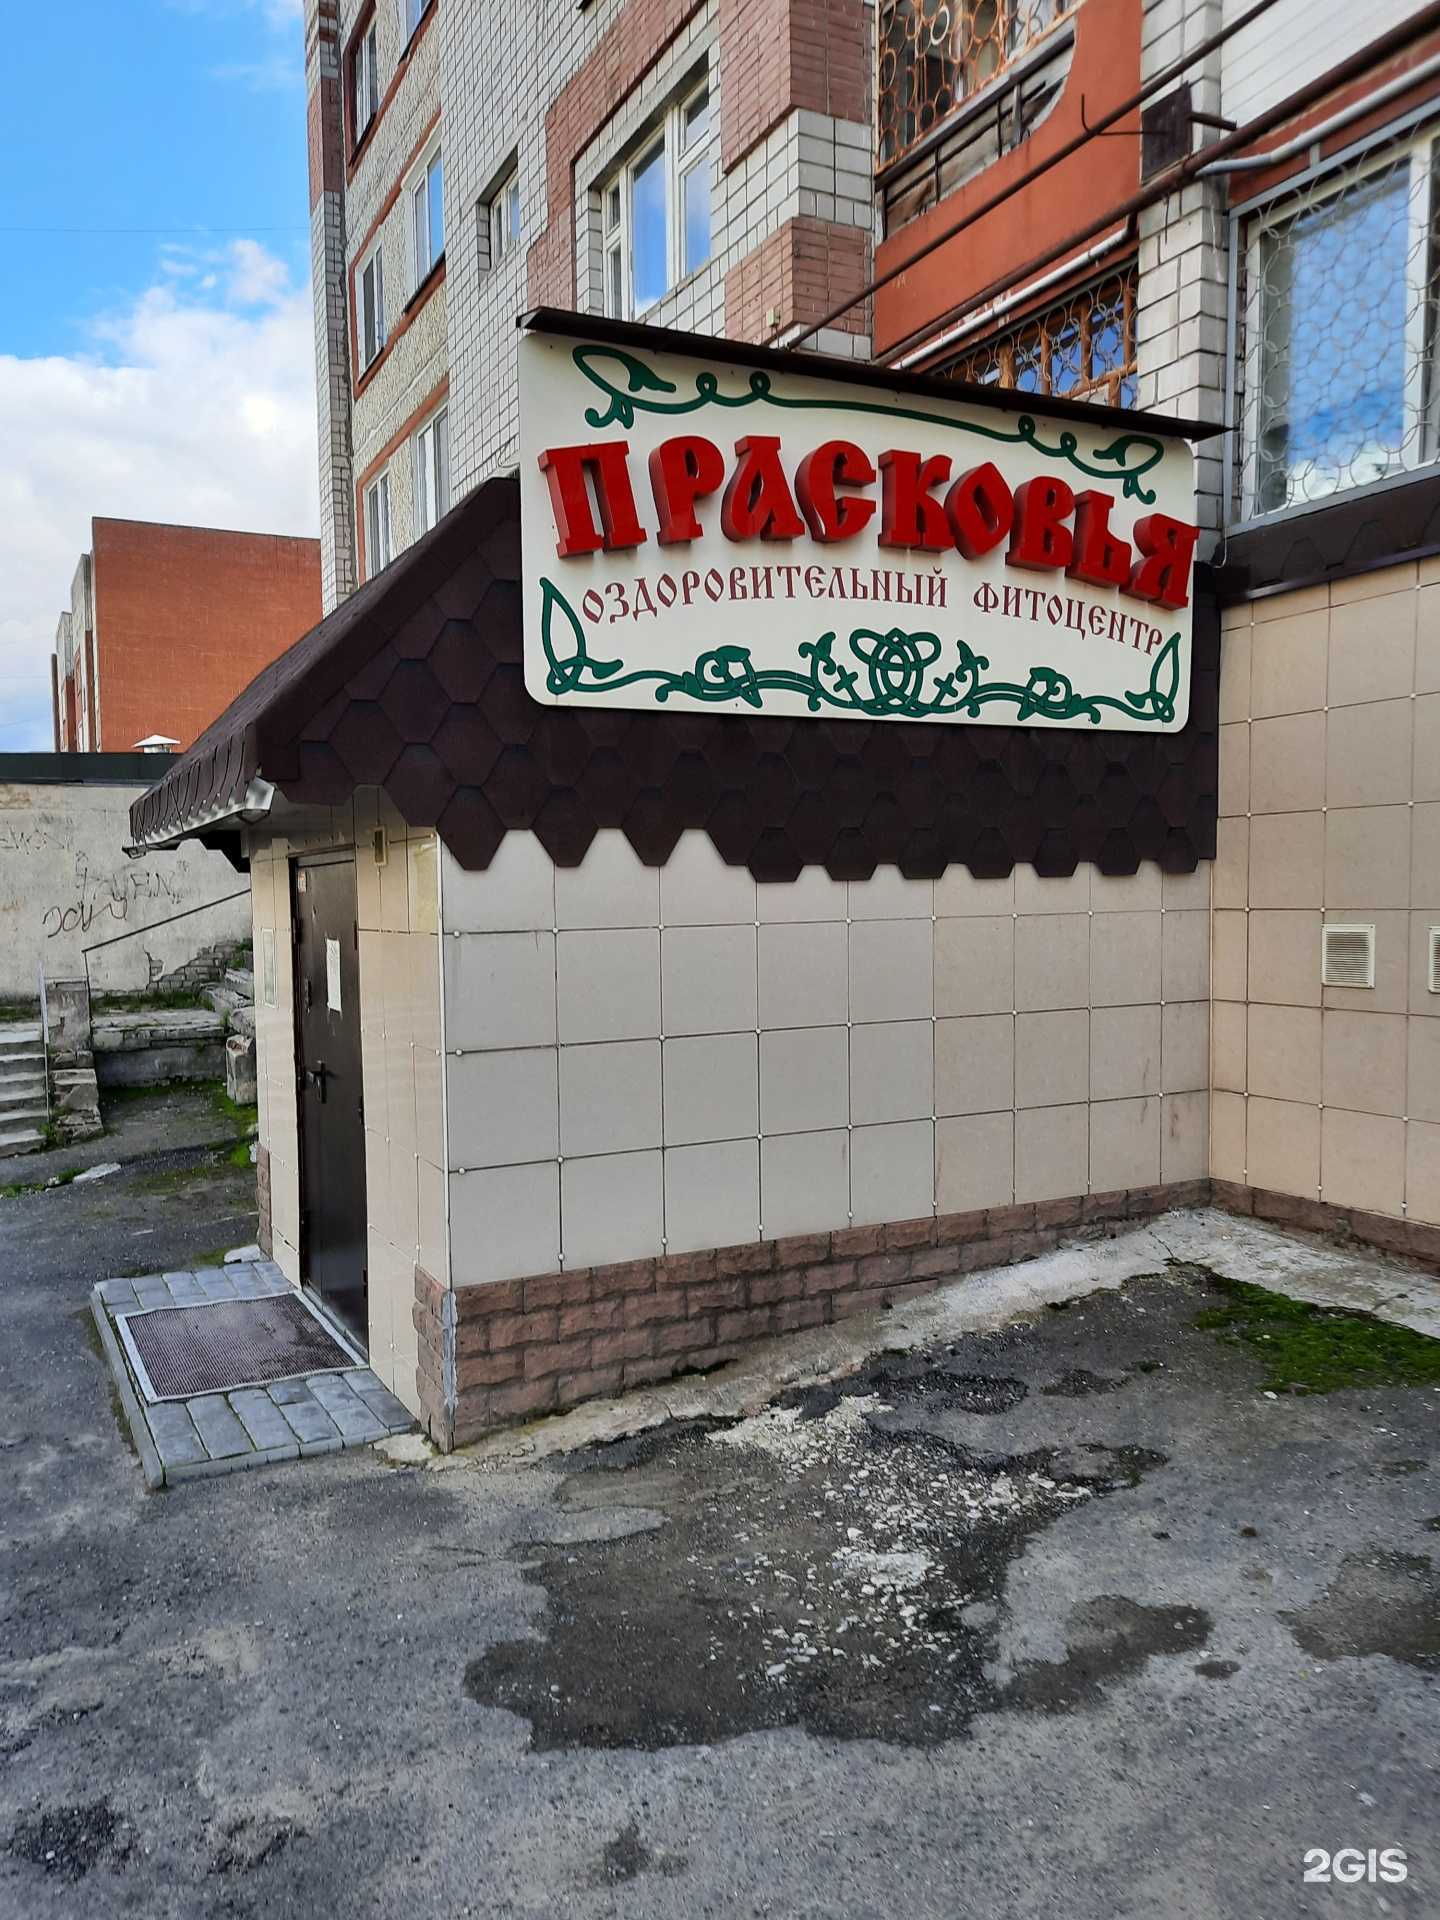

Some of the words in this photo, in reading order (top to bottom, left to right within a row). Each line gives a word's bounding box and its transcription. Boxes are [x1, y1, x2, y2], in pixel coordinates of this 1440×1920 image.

[540, 435, 1199, 610] ПРАСКОВЬЯ
[582, 566, 948, 624] ОЗДОРОВИТЕЛЬНЫЙ
[973, 581, 1163, 656] ФИТОЦЕНТР
